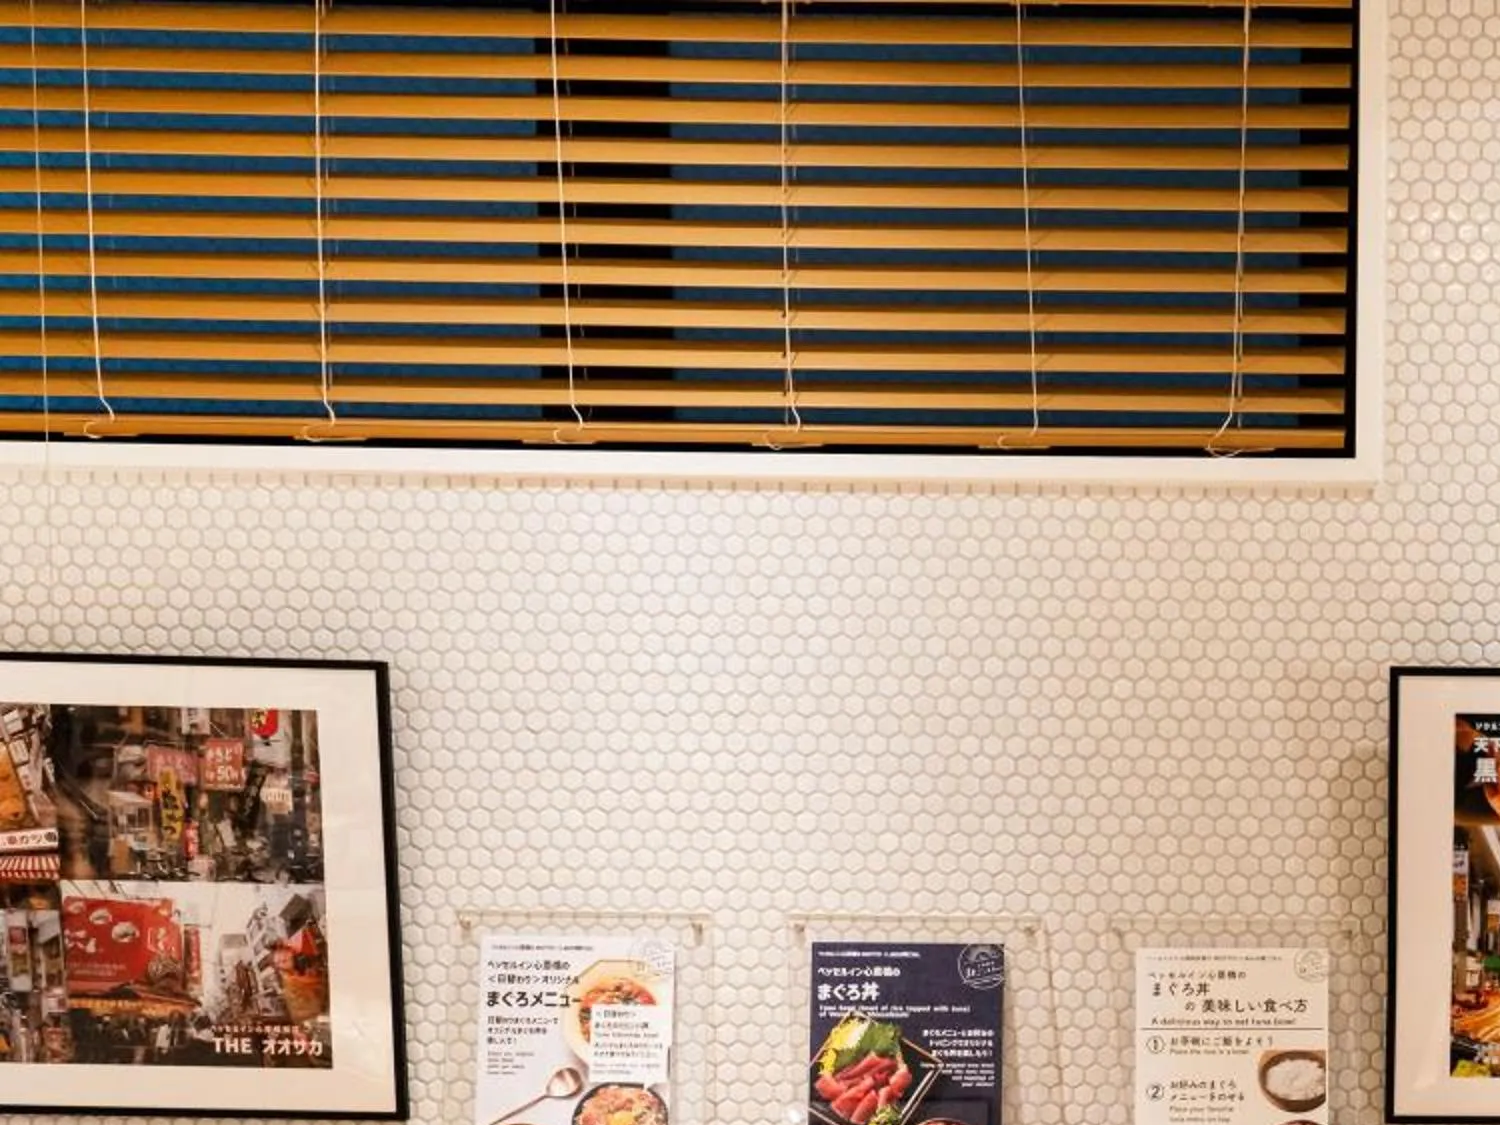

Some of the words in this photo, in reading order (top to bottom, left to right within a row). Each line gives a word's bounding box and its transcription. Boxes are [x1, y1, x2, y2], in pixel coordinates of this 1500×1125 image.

[817, 981, 881, 1001] まぐろ丼
[1152, 981, 1211, 997] まぐろ丼
[486, 990, 582, 1008] まぐろメニュー
[211, 1037, 253, 1054] THE
[261, 1037, 324, 1056] オオサカ
